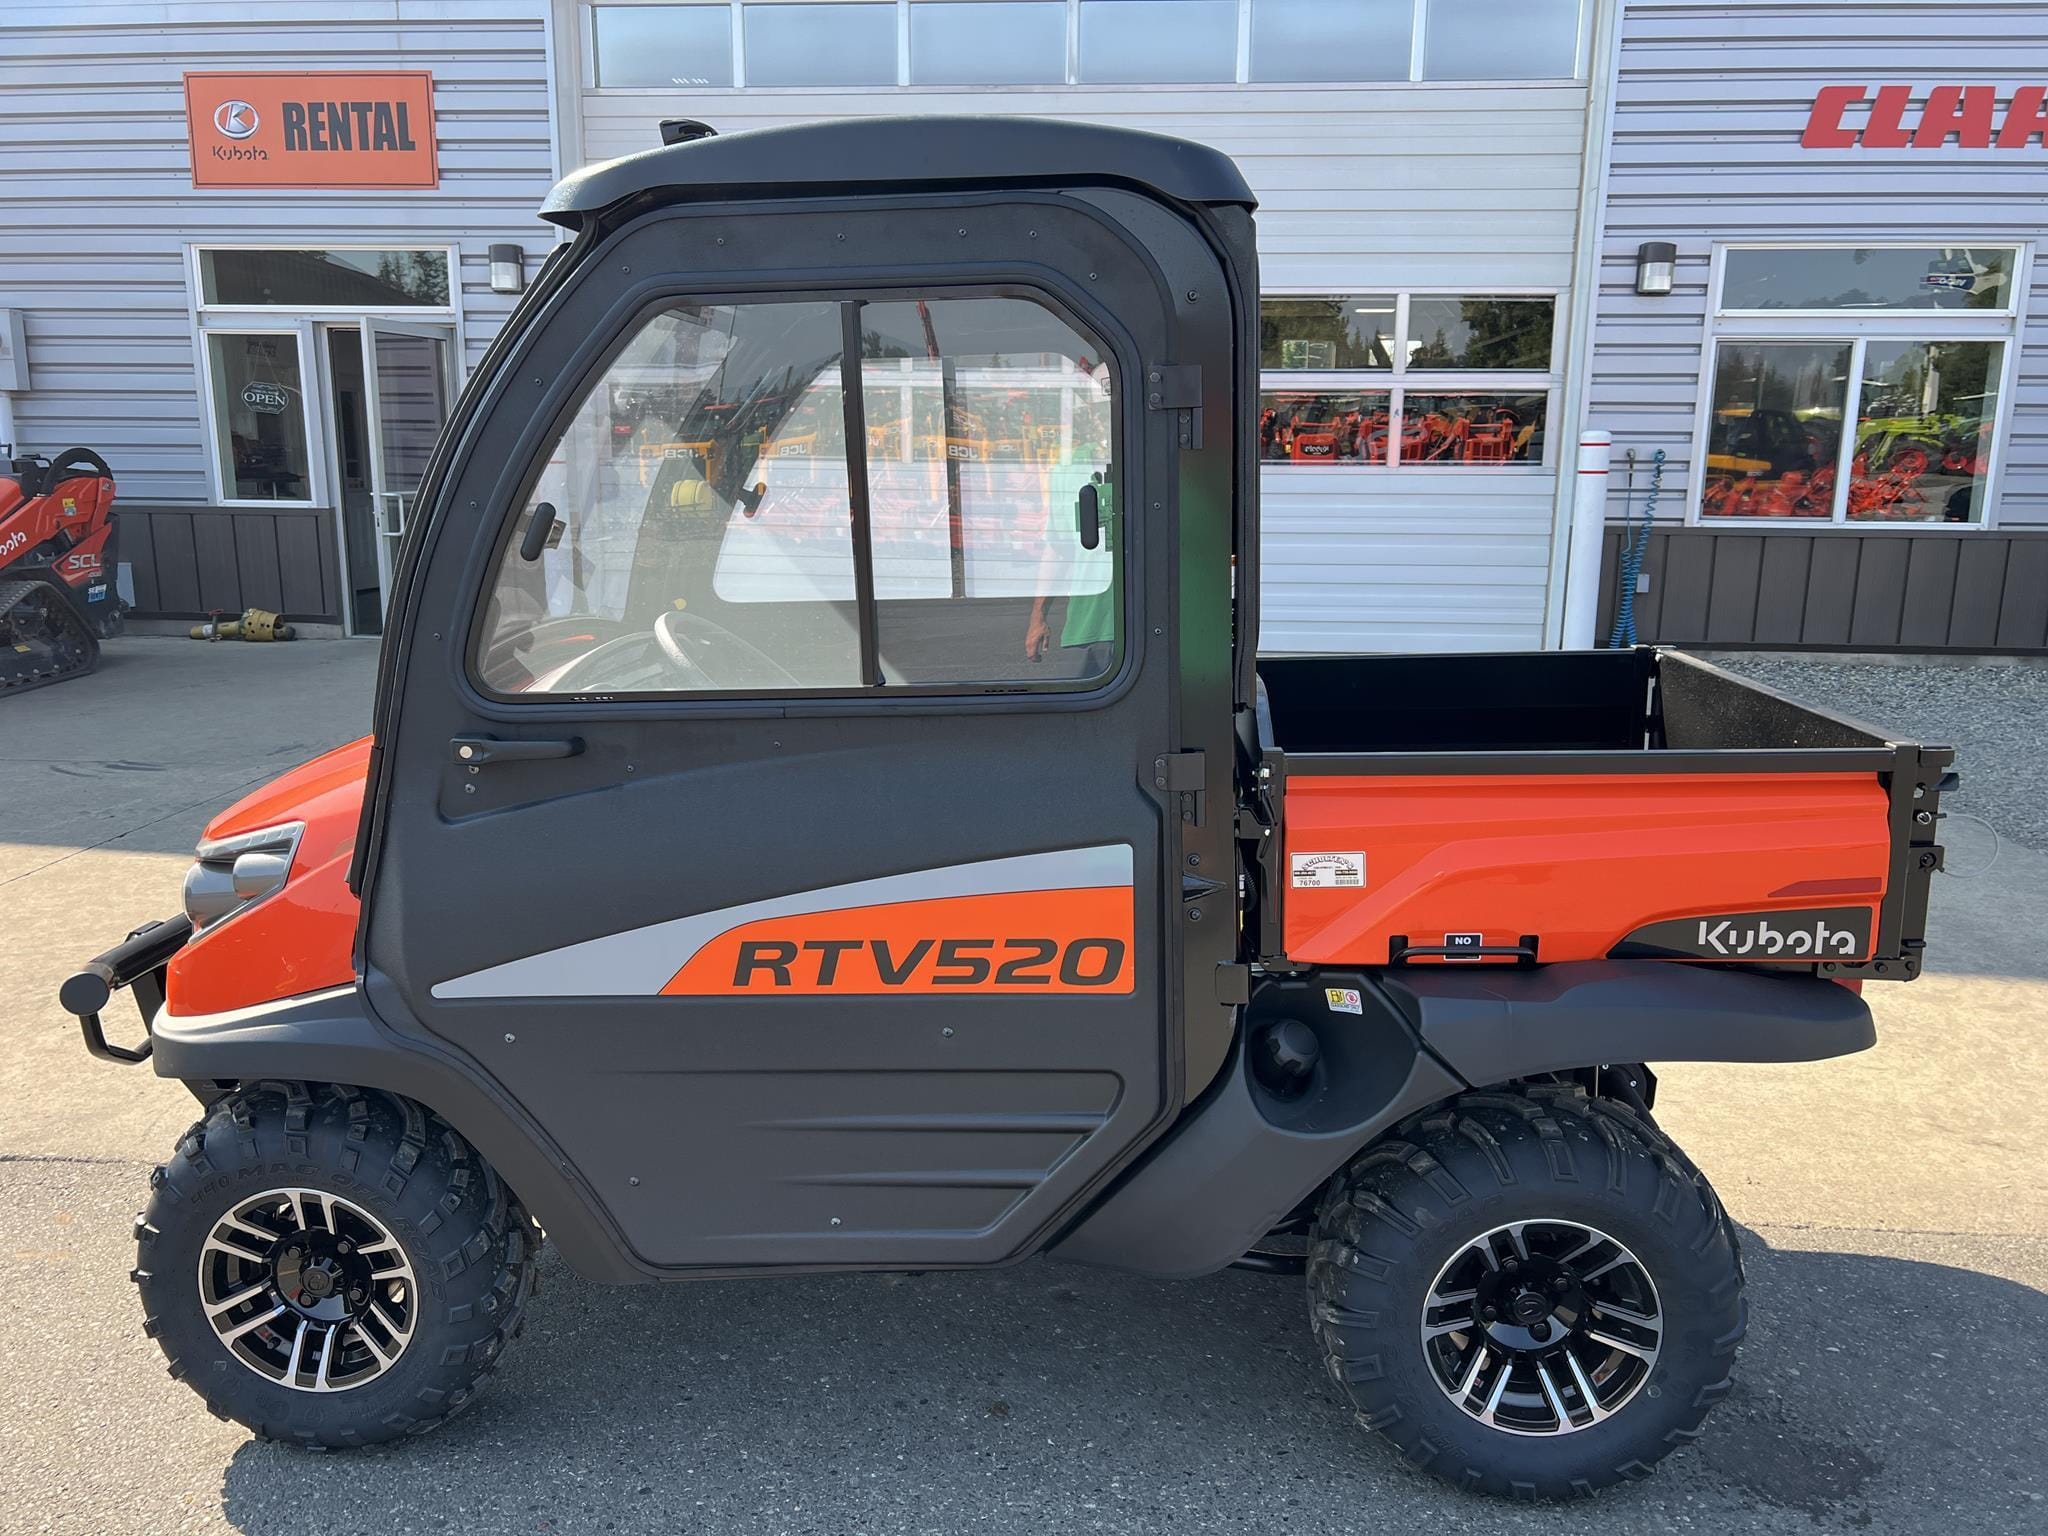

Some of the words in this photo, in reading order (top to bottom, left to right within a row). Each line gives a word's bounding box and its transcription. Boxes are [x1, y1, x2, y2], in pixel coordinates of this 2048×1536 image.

[282, 101, 417, 151] RENTAL
[212, 145, 267, 161] Kubota
[244, 391, 286, 405] OPEN
[68, 554, 101, 569] SCL
[1455, 937, 1472, 945] NO
[1698, 921, 1856, 954] Kubota
[732, 938, 1126, 986] RTV520
